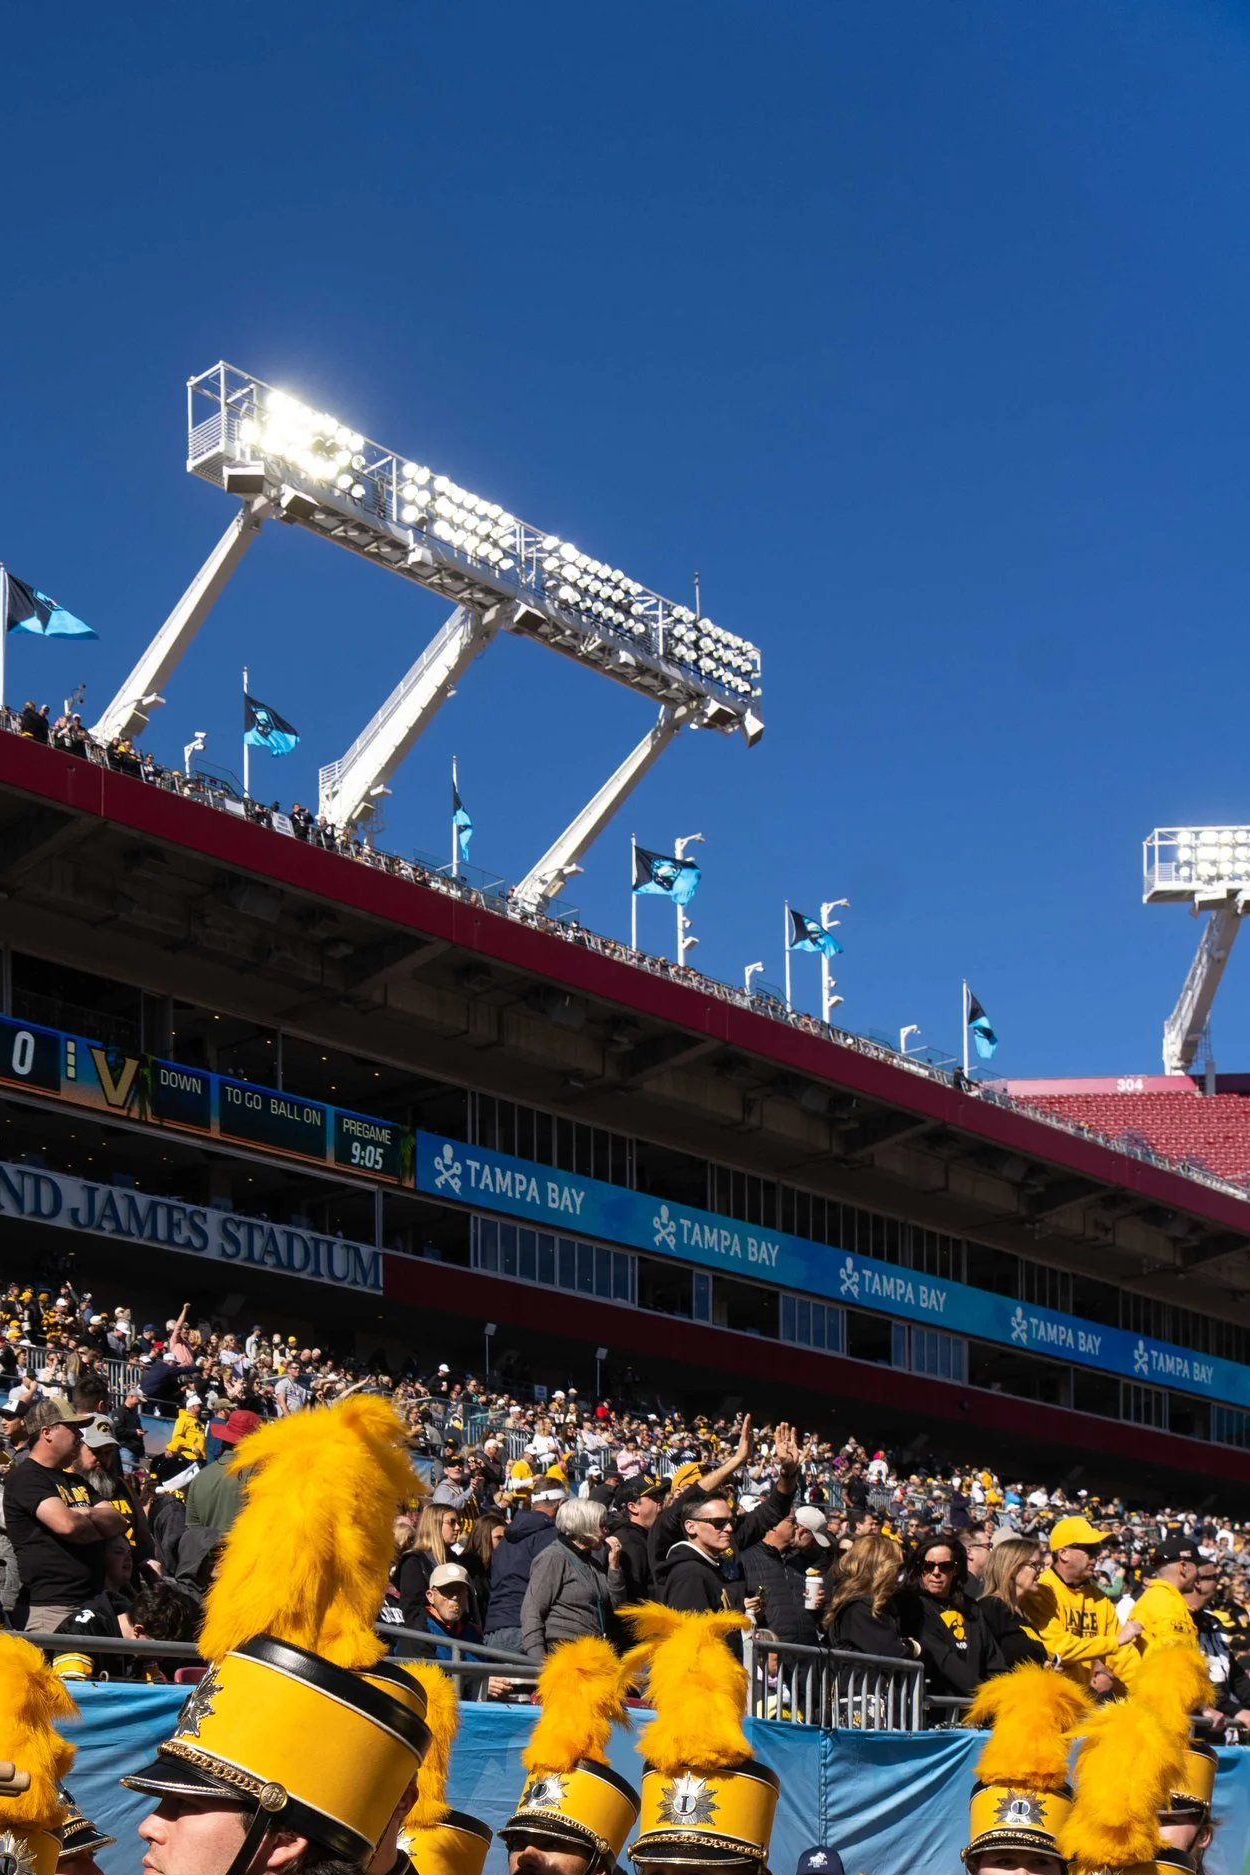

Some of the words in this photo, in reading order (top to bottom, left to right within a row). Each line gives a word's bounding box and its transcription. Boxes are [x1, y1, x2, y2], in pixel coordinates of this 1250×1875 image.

[12, 1030, 35, 1075] 0
[160, 1069, 202, 1095] DOWN
[1116, 1078, 1144, 1091] 304
[224, 1086, 243, 1106] TO
[244, 1091, 262, 1110] GO
[270, 1099, 301, 1121] BALL
[303, 1107, 321, 1127] ON
[342, 1118, 391, 1145] PREGAME
[350, 1141, 384, 1170] 9:05
[466, 1160, 539, 1206] TAMPA
[547, 1182, 585, 1216] BAY
[69, 1180, 209, 1252] JAMES
[220, 1216, 384, 1292] STADIUM
[679, 1220, 742, 1257] TAMPA
[747, 1237, 780, 1268] BAY
[862, 1269, 916, 1304] TAMPA
[919, 1286, 947, 1313] BAY
[1028, 1317, 1075, 1348] TAMPA
[1076, 1331, 1102, 1356] BAY
[1151, 1351, 1189, 1379] TAMPA
[1192, 1363, 1214, 1386] BAY
